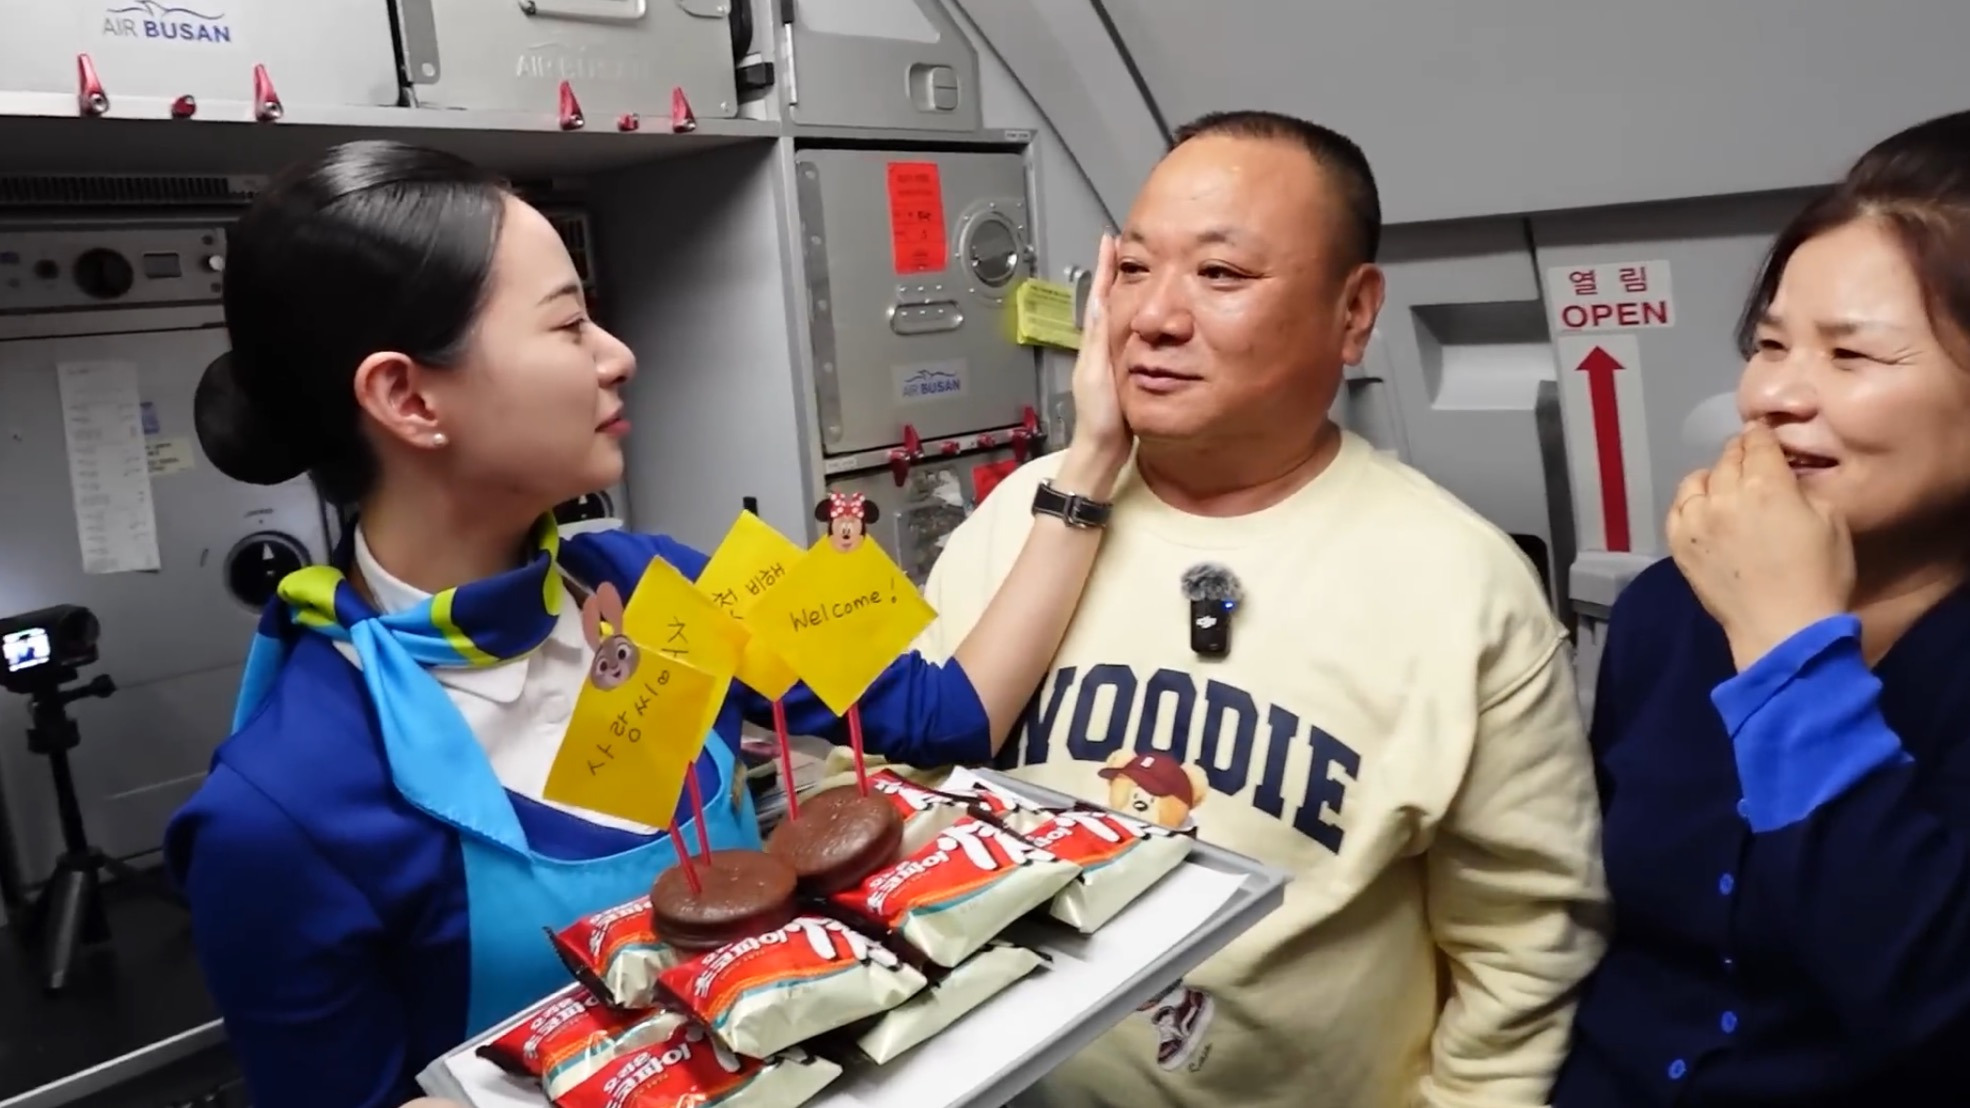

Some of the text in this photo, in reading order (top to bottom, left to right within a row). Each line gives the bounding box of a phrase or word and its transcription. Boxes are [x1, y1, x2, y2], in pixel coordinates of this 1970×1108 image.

[103, 18, 231, 42] AIR BUSAN
[1562, 301, 1668, 328] OPEN
[920, 379, 960, 395] BUSAN
[993, 664, 1361, 856] WOODIE
